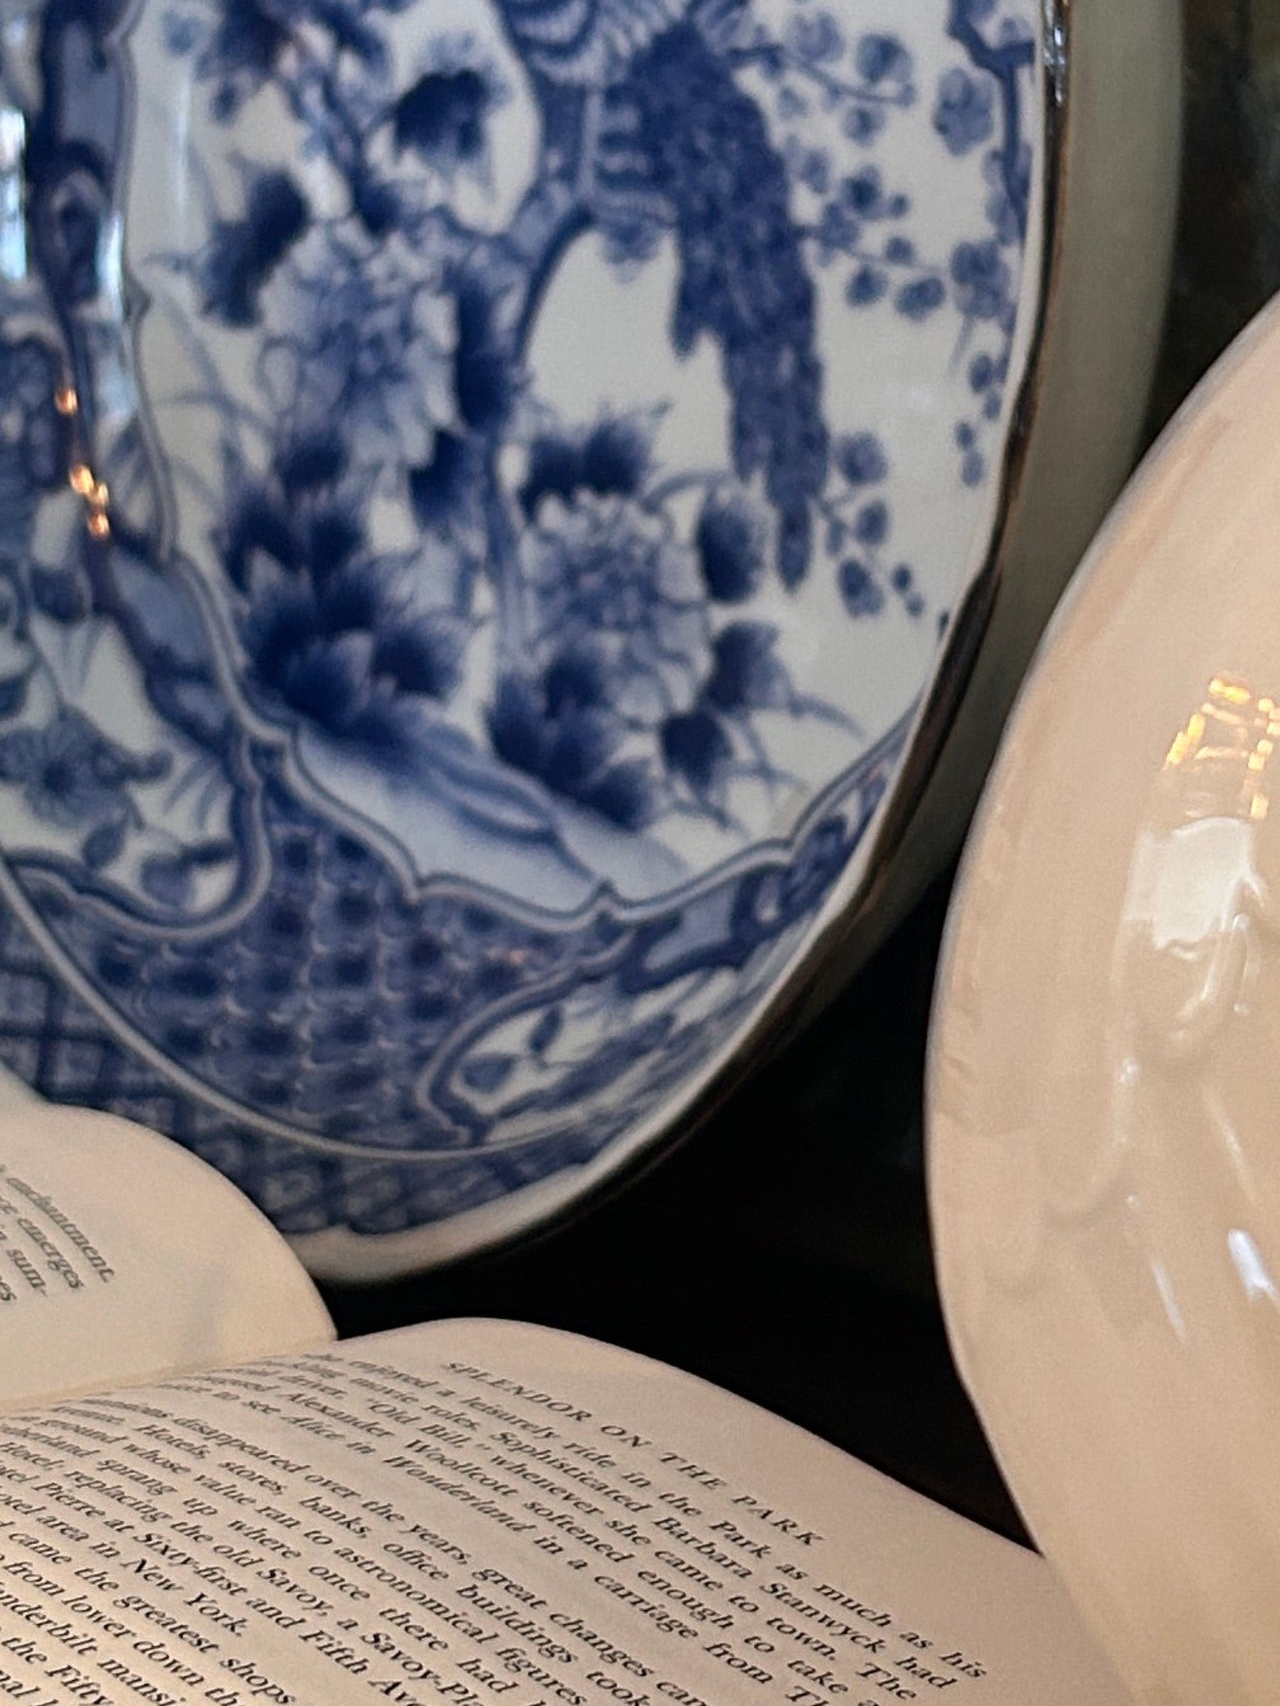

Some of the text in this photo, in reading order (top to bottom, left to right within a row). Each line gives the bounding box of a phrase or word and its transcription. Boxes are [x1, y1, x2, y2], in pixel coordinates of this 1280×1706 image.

[440, 1362, 825, 1547] SPLENDOR ON THE PARK
[118, 1557, 249, 1638] New York.
[332, 1546, 499, 1645] astronomical
[382, 1542, 450, 1582] office
[454, 1582, 579, 1664] buildings
[487, 1431, 959, 1690] Sophisticated Barbara Stanwyck had
[487, 1446, 918, 1702] whenever she came town. The
[522, 1501, 850, 1695] softened enough take
[707, 1519, 988, 1679] Park much his
[111, 1595, 221, 1655] greatest
[219, 1657, 297, 1706] shops
[131, 1640, 206, 1688] down
[297, 1618, 371, 1676] Fifth
[378, 1607, 450, 1652] there
[454, 1657, 521, 1695] had
[470, 1568, 549, 1611] great
[548, 1612, 655, 1679] changes
[593, 1575, 699, 1640] carriage
[701, 1641, 774, 1686] from
